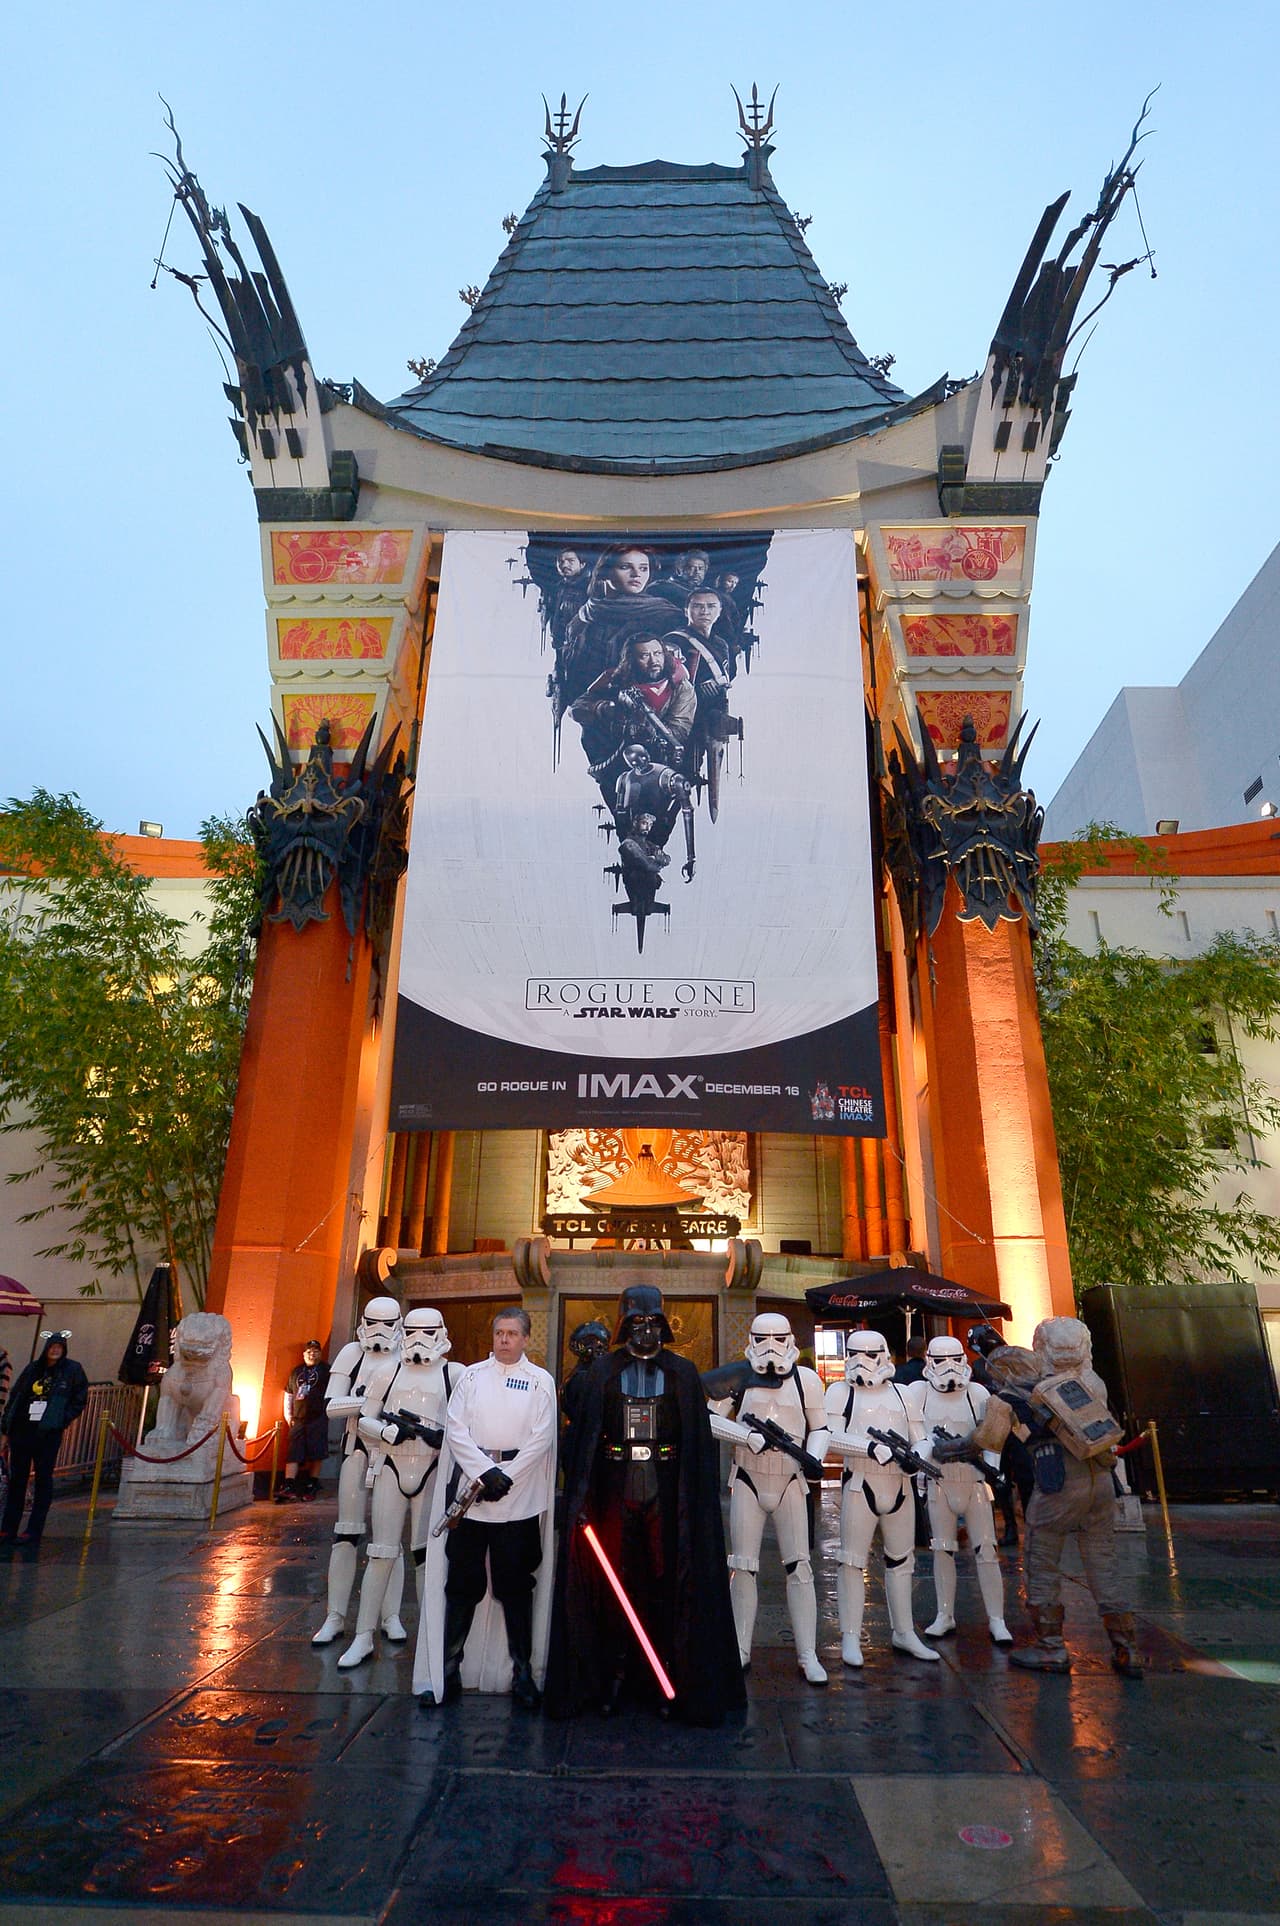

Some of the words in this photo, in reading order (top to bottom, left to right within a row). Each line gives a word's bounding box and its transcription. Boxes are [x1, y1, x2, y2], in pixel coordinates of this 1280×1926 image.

[537, 983, 654, 1004] ROGUE
[675, 983, 745, 1007] ONE
[562, 1009, 570, 1017] A
[573, 1007, 626, 1018] STAR
[629, 1007, 680, 1018] WARS
[477, 1082, 497, 1092] GO
[501, 1081, 548, 1091] ROGUE
[552, 1081, 567, 1091] IN
[705, 1083, 781, 1096] DECEMBER
[785, 1086, 800, 1096] 16
[837, 1085, 873, 1099] TCL
[838, 1098, 873, 1107] CHINESE
[839, 1105, 873, 1115] THEATRE
[840, 1112, 873, 1121] IMAX
[553, 1219, 591, 1233] TCL
